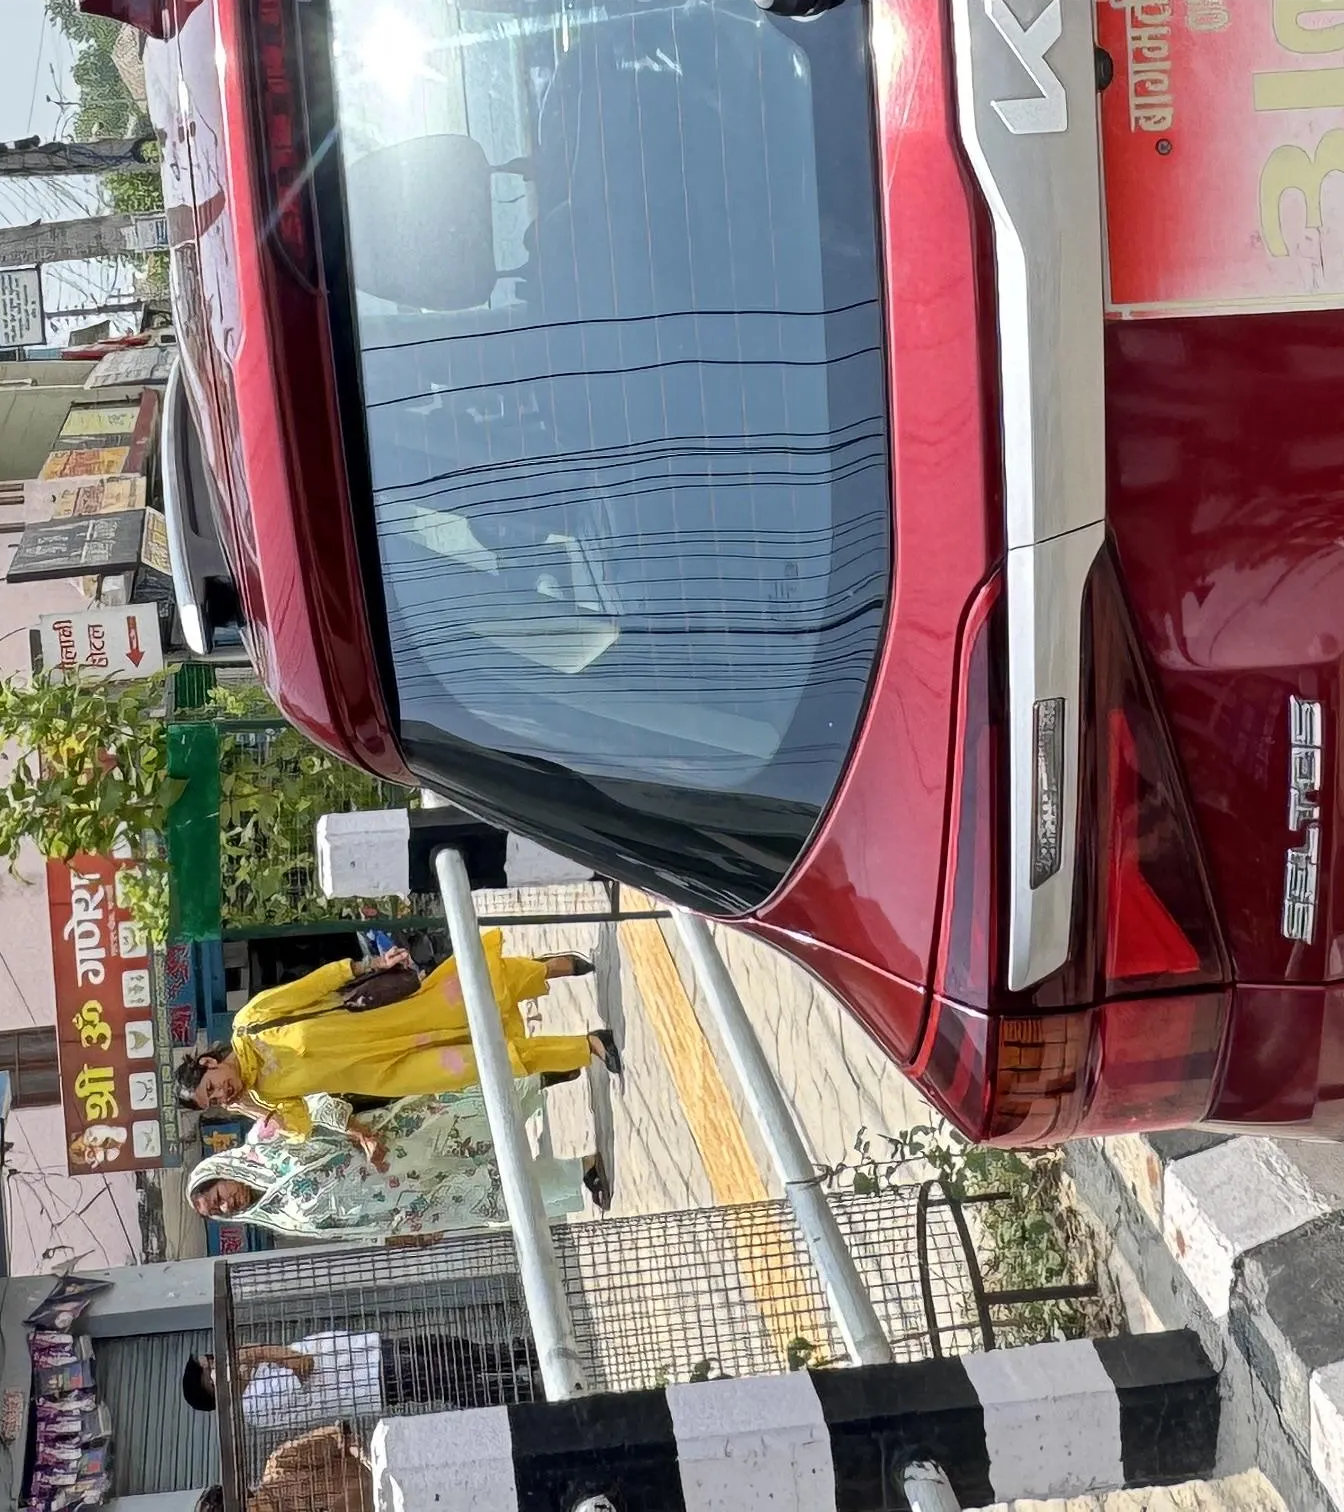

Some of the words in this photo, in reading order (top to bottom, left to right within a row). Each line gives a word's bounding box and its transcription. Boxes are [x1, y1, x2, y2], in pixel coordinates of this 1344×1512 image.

[1281, 694, 1322, 945] SELTOS
[63, 872, 106, 987] गणेश
[72, 1000, 112, 1050] ॐ
[74, 1064, 118, 1121] श्री
